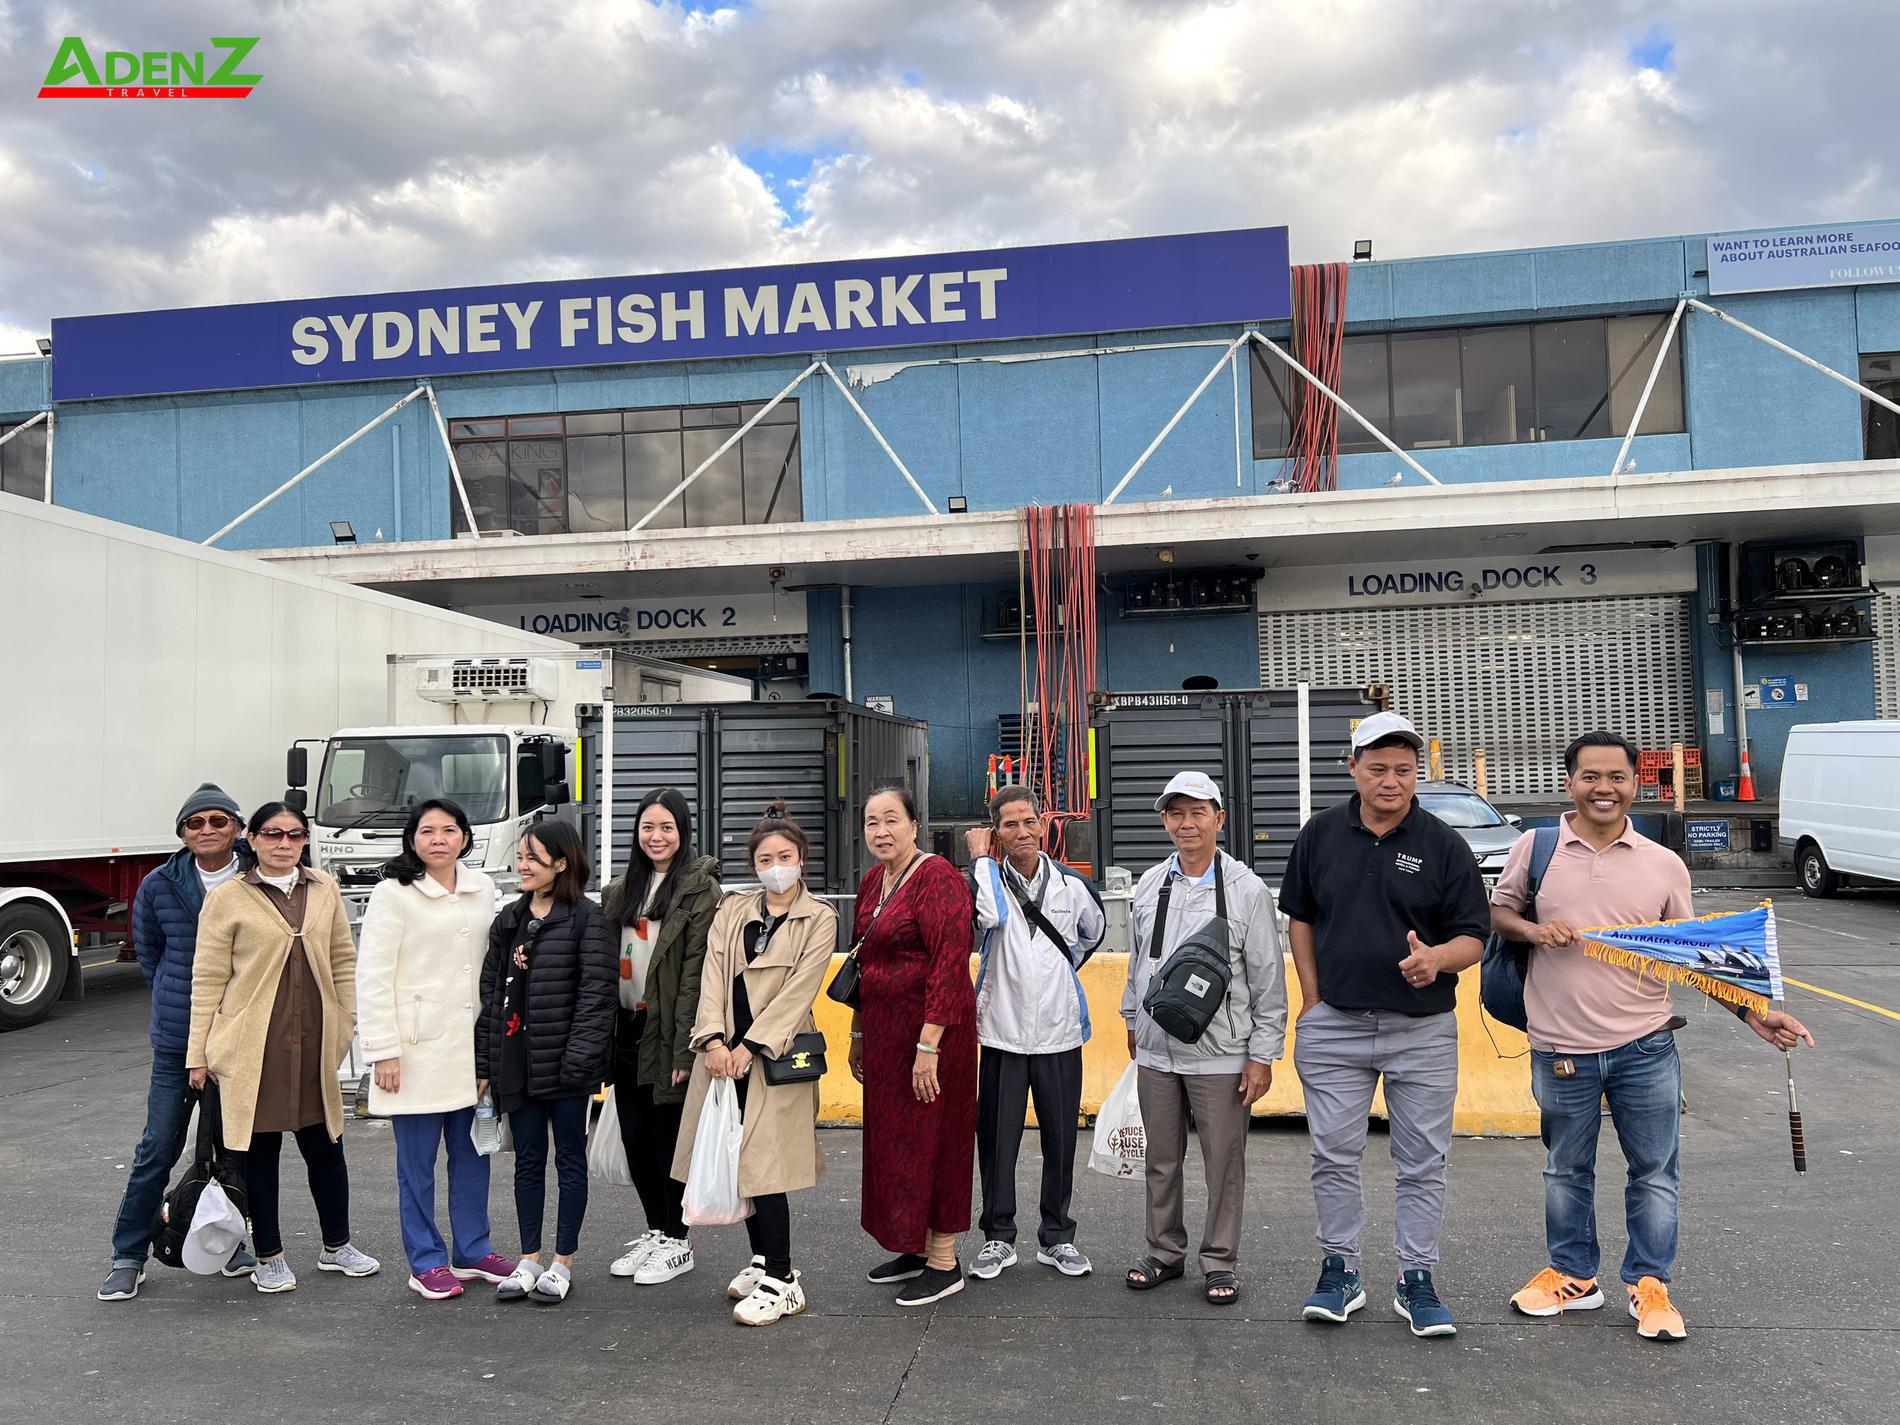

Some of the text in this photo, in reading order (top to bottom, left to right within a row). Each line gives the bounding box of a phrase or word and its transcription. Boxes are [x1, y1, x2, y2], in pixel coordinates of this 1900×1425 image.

[1713, 233, 1853, 252] WANT TO LEARN MORE
[1720, 252, 1763, 263] ABOUT
[1767, 244, 1847, 259] AUSTRALIAN
[1830, 265, 1884, 279] FOLLOW
[291, 268, 1008, 366] SYDNEY FISH MARKET
[511, 443, 558, 460] KING
[1349, 564, 1597, 596] LOADING DOCK 3
[521, 606, 736, 634] LOADING DOCK 2
[320, 845, 354, 853] HINO
[1397, 852, 1423, 864] TRUMP
[666, 1251, 690, 1270] HEART
